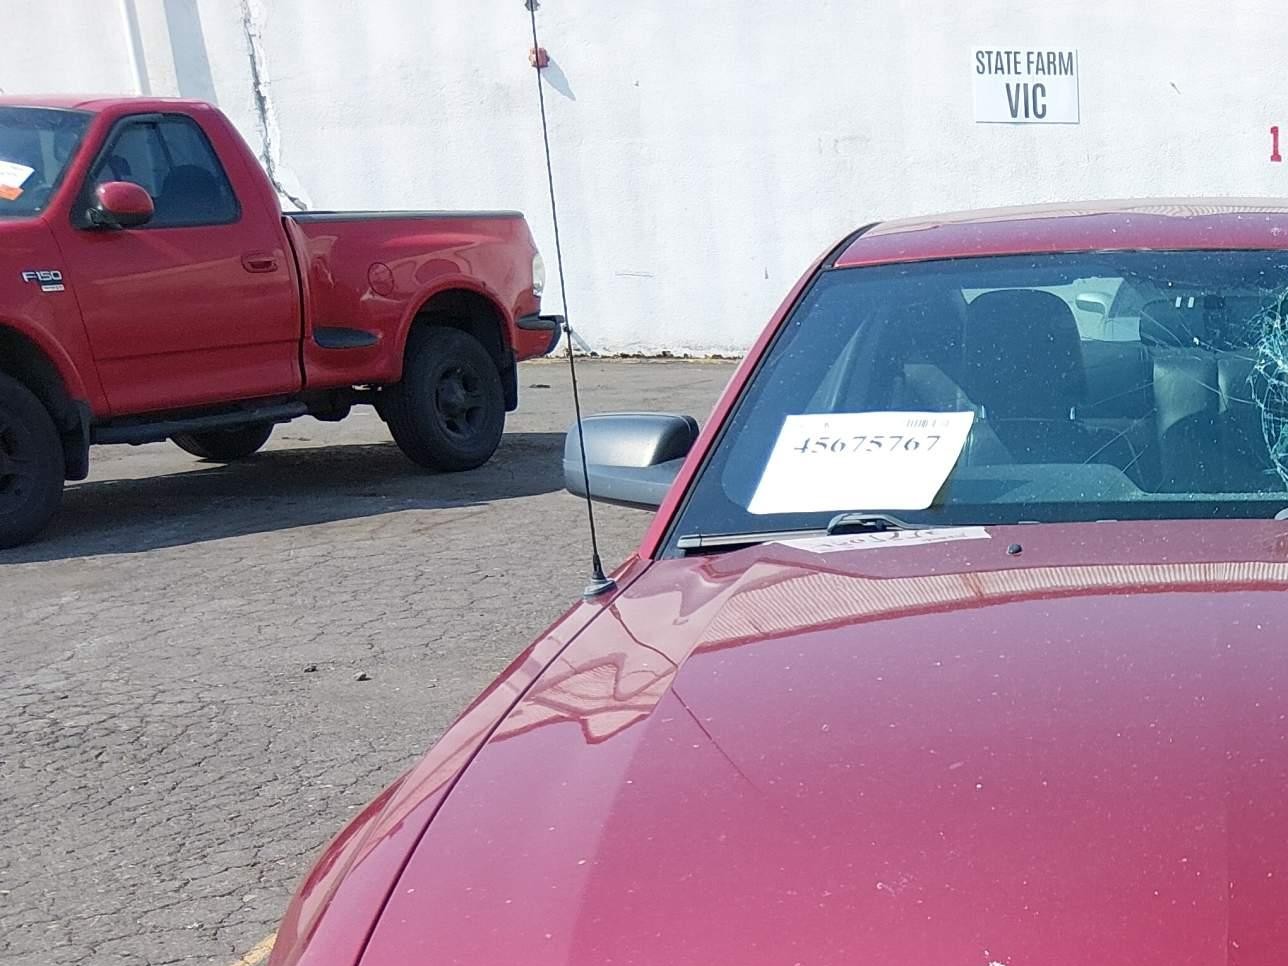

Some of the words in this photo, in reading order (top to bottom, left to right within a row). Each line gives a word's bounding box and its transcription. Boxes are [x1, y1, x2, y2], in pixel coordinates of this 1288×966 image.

[975, 50, 1022, 75] STATE
[1026, 51, 1073, 76] FARM
[1005, 82, 1047, 119] VIC
[794, 435, 941, 453] 45675767
